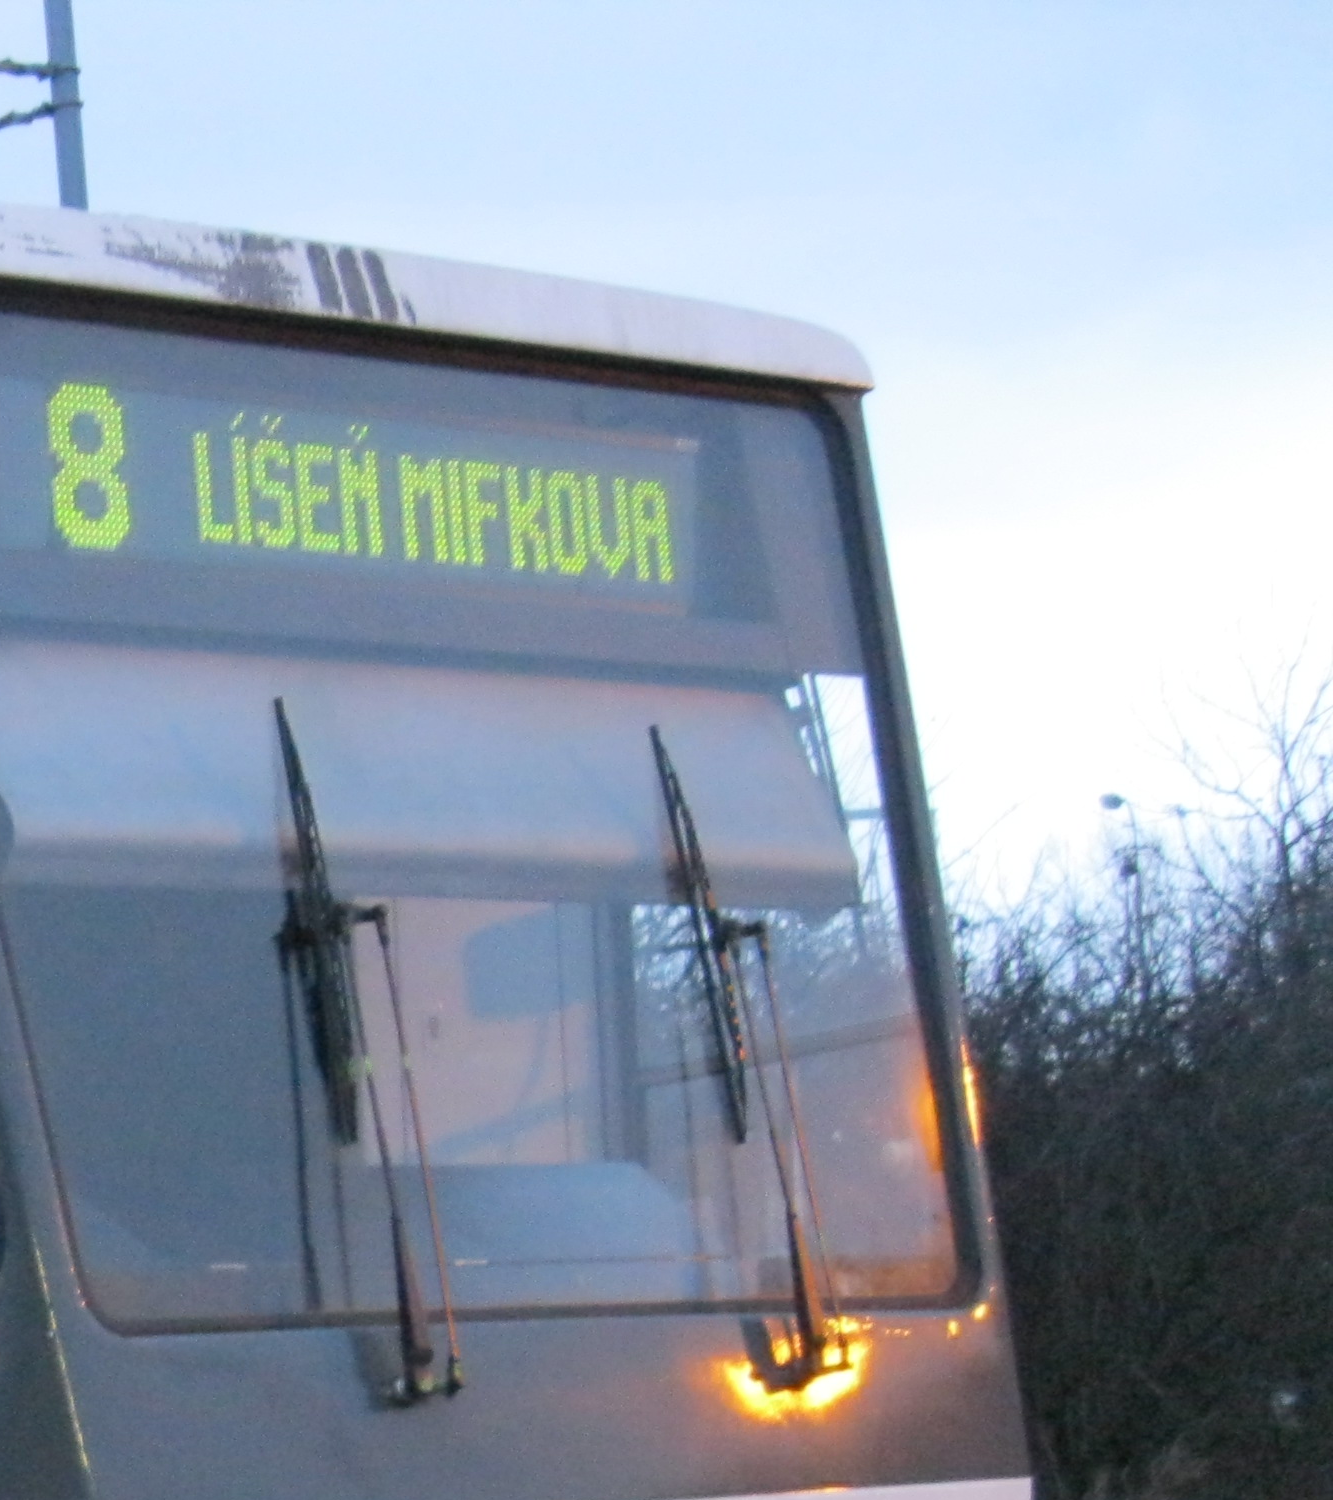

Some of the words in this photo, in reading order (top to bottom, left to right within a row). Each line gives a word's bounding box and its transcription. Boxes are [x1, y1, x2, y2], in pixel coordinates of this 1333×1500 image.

[46, 382, 130, 551] 8
[191, 411, 384, 558] LÍŠEŇ
[397, 451, 676, 584] MIFKOVA
